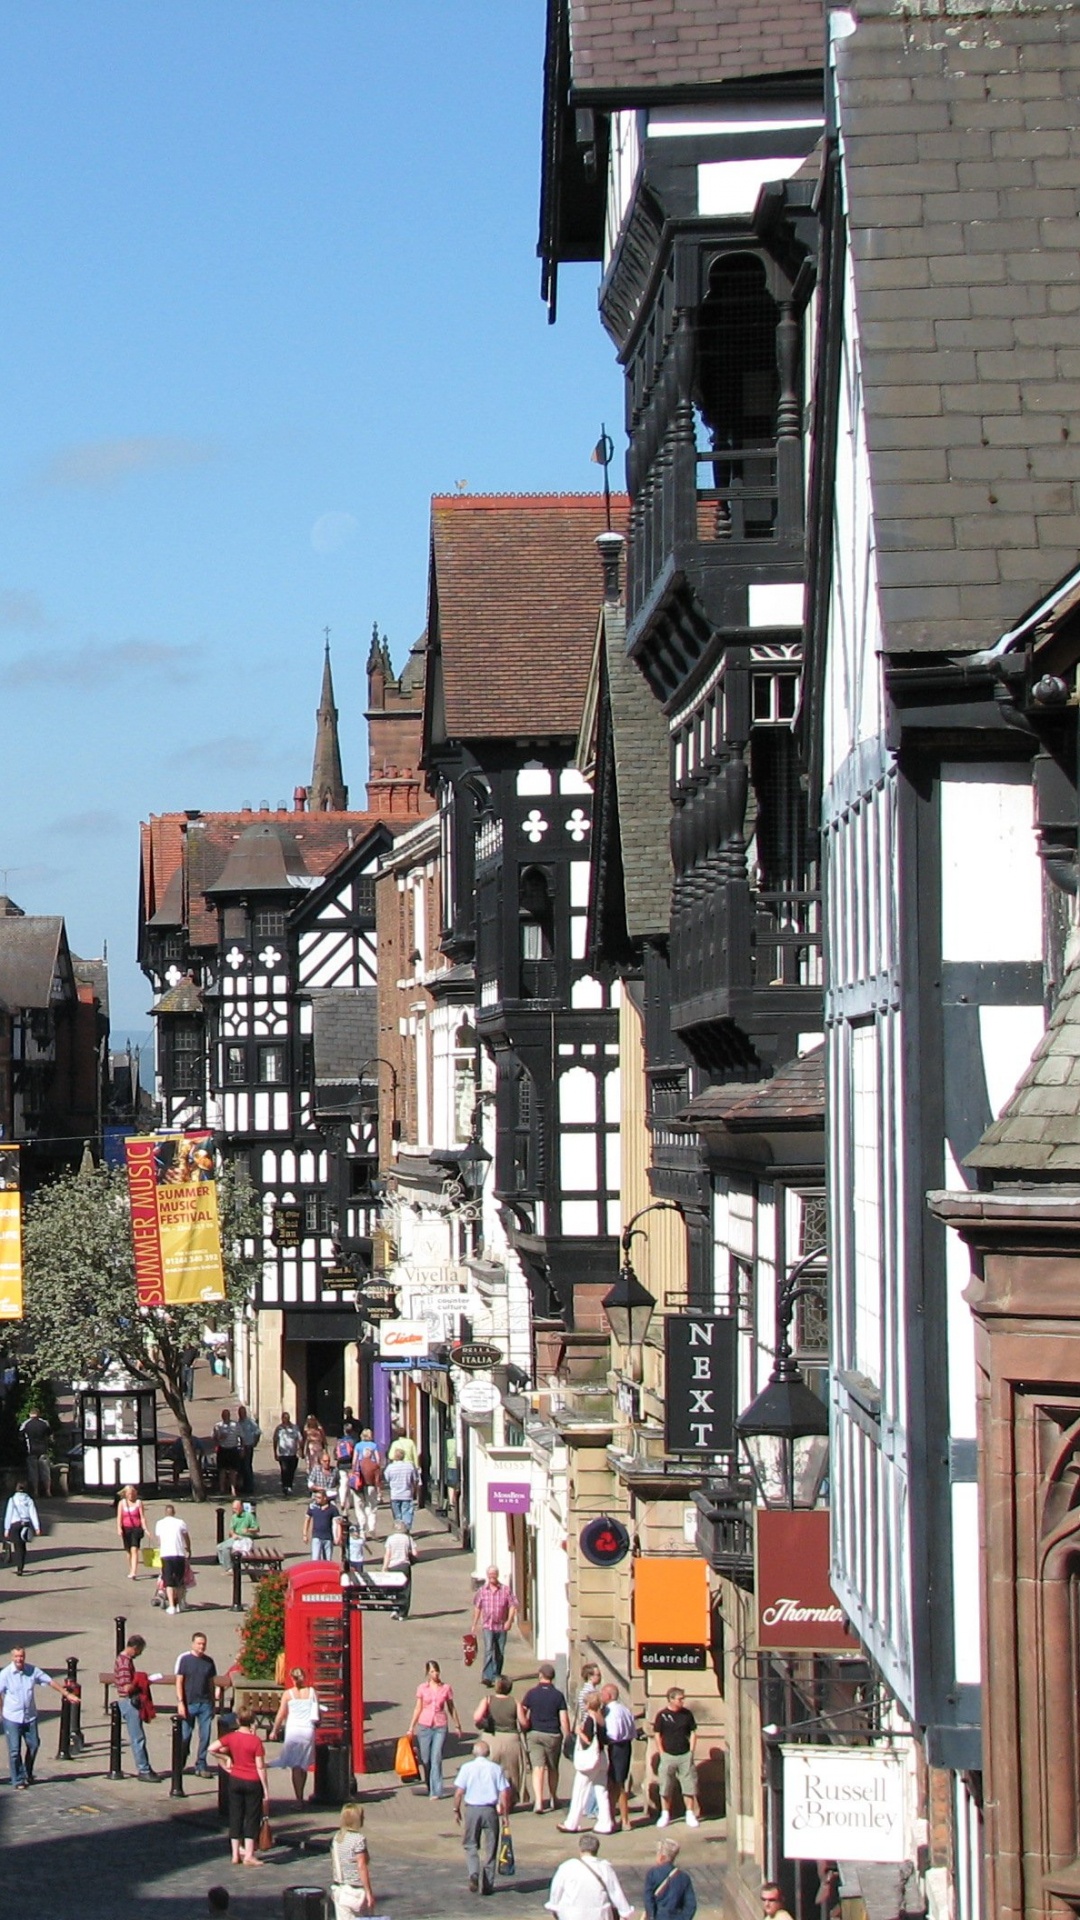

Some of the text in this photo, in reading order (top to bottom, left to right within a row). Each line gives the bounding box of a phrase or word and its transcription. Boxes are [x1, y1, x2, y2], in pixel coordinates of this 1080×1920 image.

[158, 1186, 209, 1200] SUMMER
[160, 1200, 197, 1212] MUSIC
[126, 1147, 163, 1304] SUMMER MUSIC
[160, 1211, 213, 1224] FESTIVAL
[405, 1267, 459, 1285] Viyella
[688, 1322, 715, 1446] NEXT
[762, 1598, 843, 1626] Thornto
[804, 1774, 886, 1801] Russell
[806, 1800, 898, 1835] Bromley
